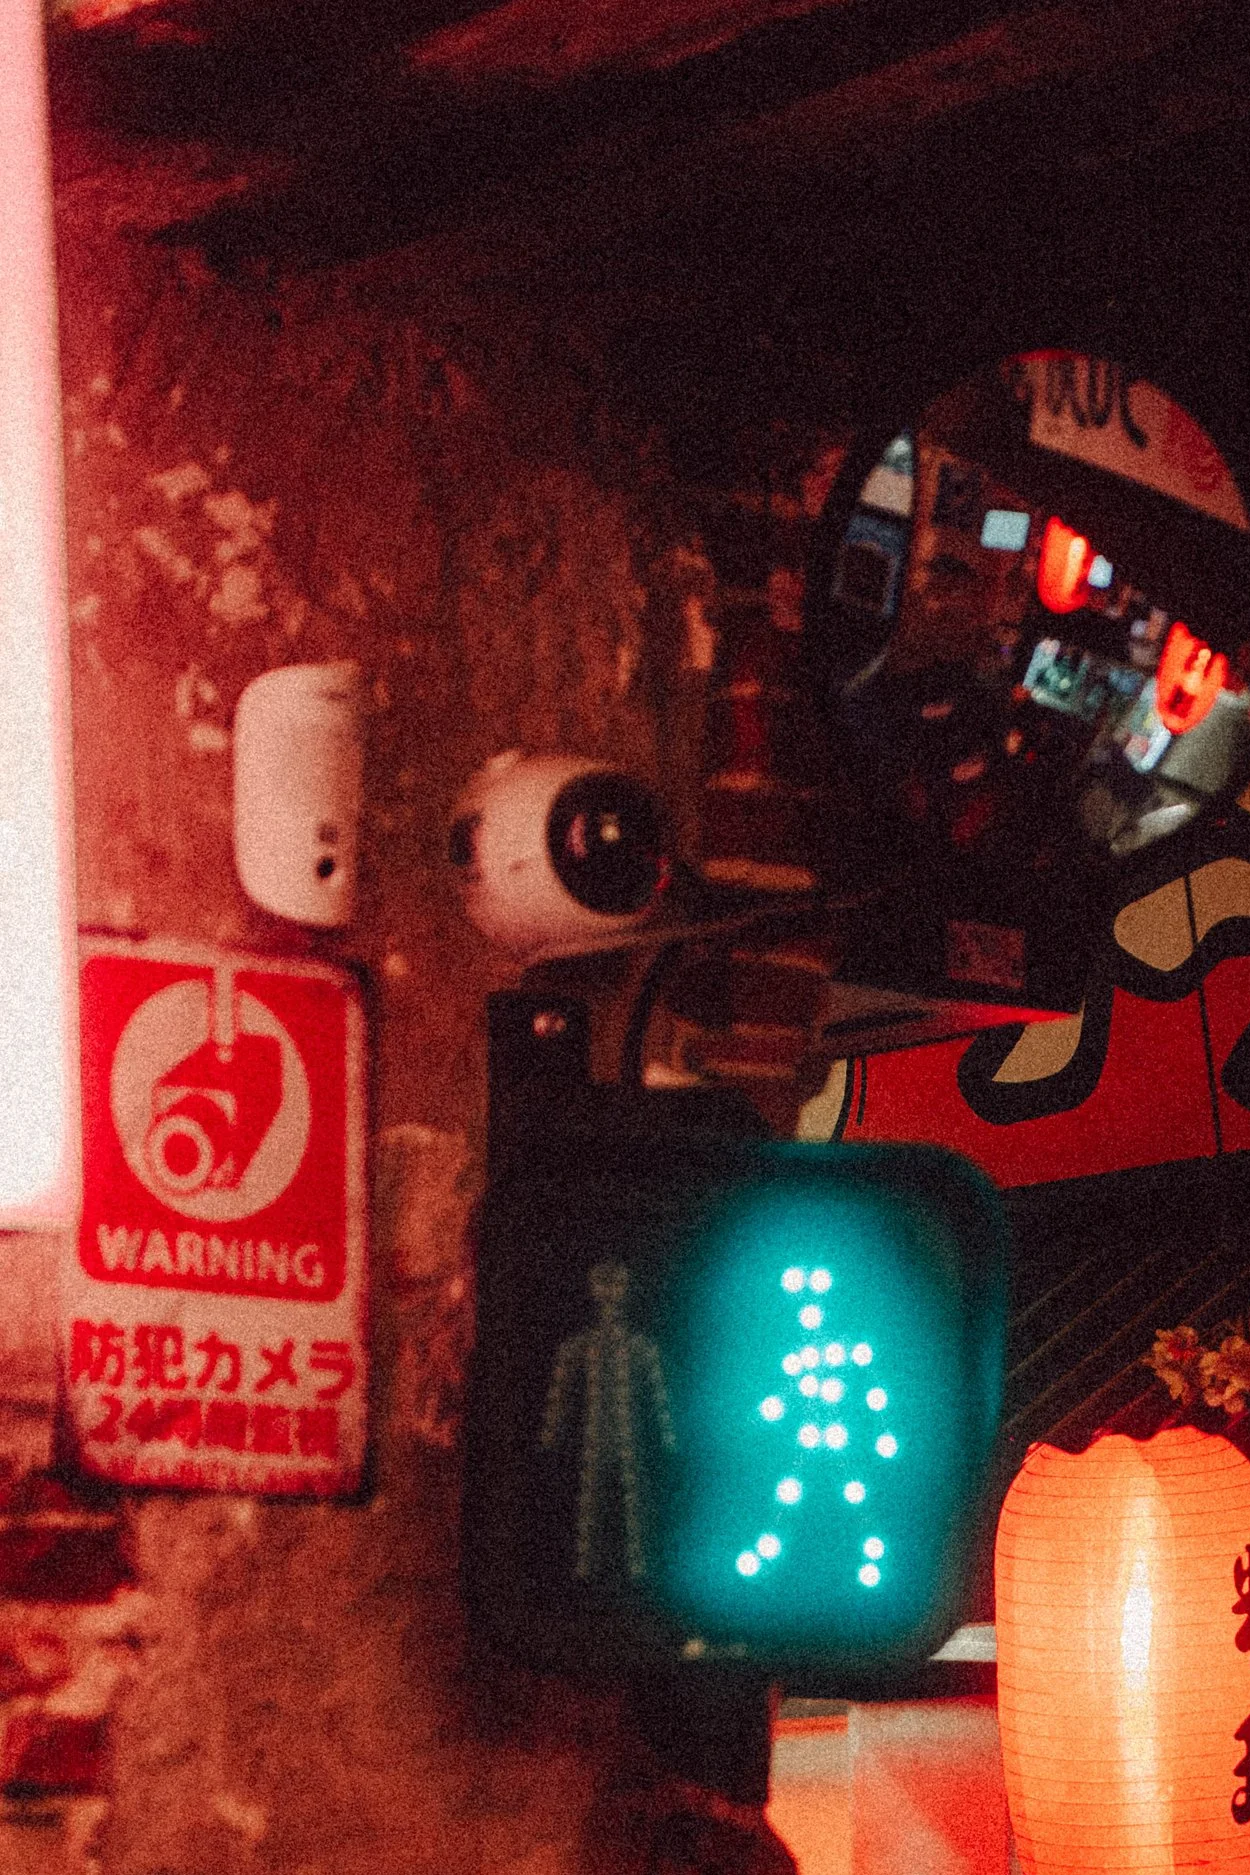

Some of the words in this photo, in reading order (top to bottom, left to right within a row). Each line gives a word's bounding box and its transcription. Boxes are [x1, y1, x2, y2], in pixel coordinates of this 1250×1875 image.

[96, 1223, 325, 1289] WARNING
[69, 1317, 355, 1400] 防犯カメラ
